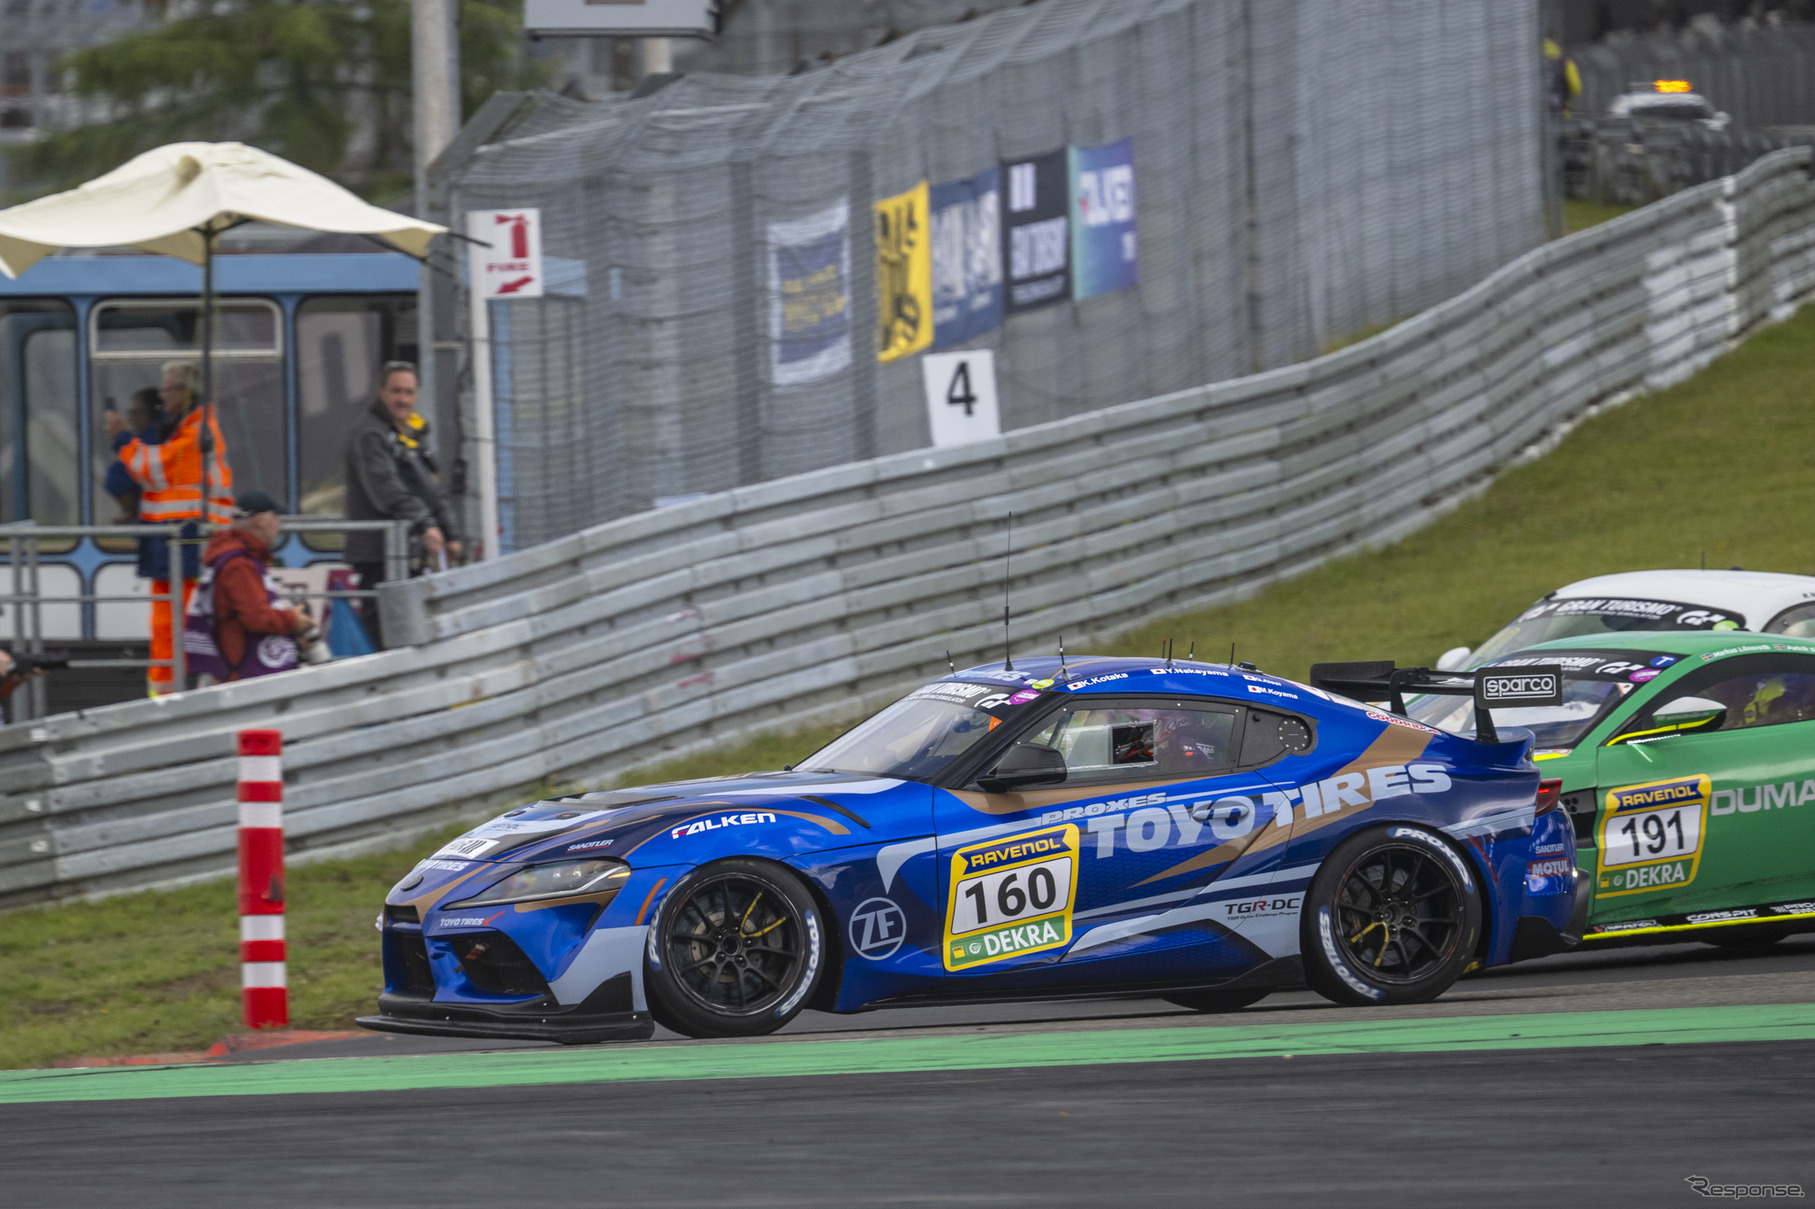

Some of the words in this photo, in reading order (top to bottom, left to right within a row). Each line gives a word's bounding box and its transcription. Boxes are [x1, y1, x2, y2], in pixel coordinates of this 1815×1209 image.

[947, 361, 977, 416] 4
[1081, 673, 1129, 687] K.Kotaka
[1165, 668, 1229, 678] Y.Nakayama
[1260, 687, 1298, 699] M.Koyama
[1487, 678, 1553, 697] sparco
[1041, 793, 1168, 825] PROXES
[1621, 788, 1697, 807] RAVENOL
[1087, 796, 1256, 859] TOYO
[1252, 764, 1452, 828] TIRES
[671, 812, 776, 839] FALKEN
[1621, 810, 1685, 857] 191
[567, 839, 614, 851] SANDTLER
[970, 838, 1061, 867] RAVENOL
[1394, 827, 1474, 887] PROXES
[1532, 860, 1569, 877] MOTUL
[1625, 863, 1686, 889] DEKRA
[965, 867, 1056, 925] 160
[1224, 898, 1301, 914] TGR-DC
[460, 918, 485, 926] TIRES
[851, 906, 903, 951] ZF
[983, 921, 1060, 956] DEKRA
